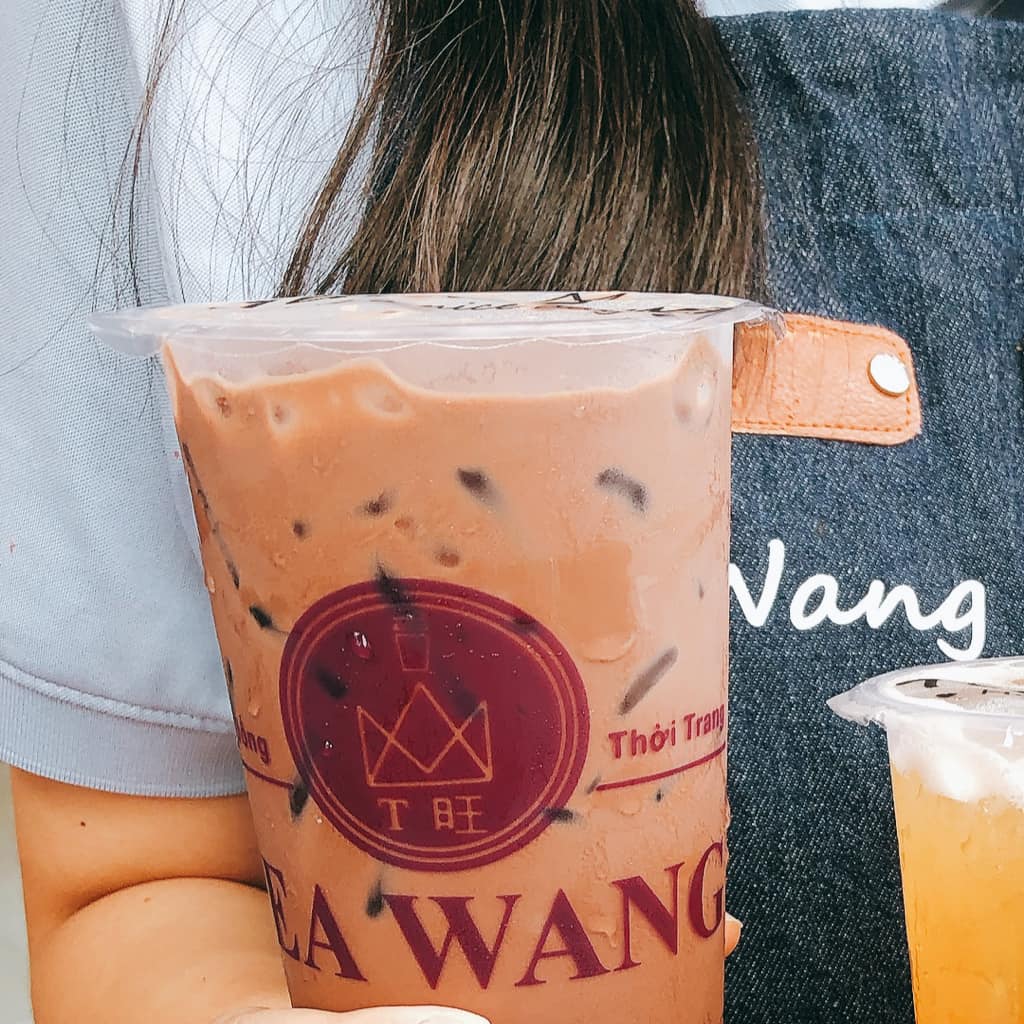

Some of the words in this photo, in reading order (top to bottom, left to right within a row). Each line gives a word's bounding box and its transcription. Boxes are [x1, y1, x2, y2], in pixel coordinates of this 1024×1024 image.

[608, 720, 677, 760] Thời
[683, 703, 726, 742] Trang
[377, 798, 409, 831] T
[432, 795, 488, 834] 旺
[260, 855, 368, 982] EA
[382, 841, 724, 991] WANG
